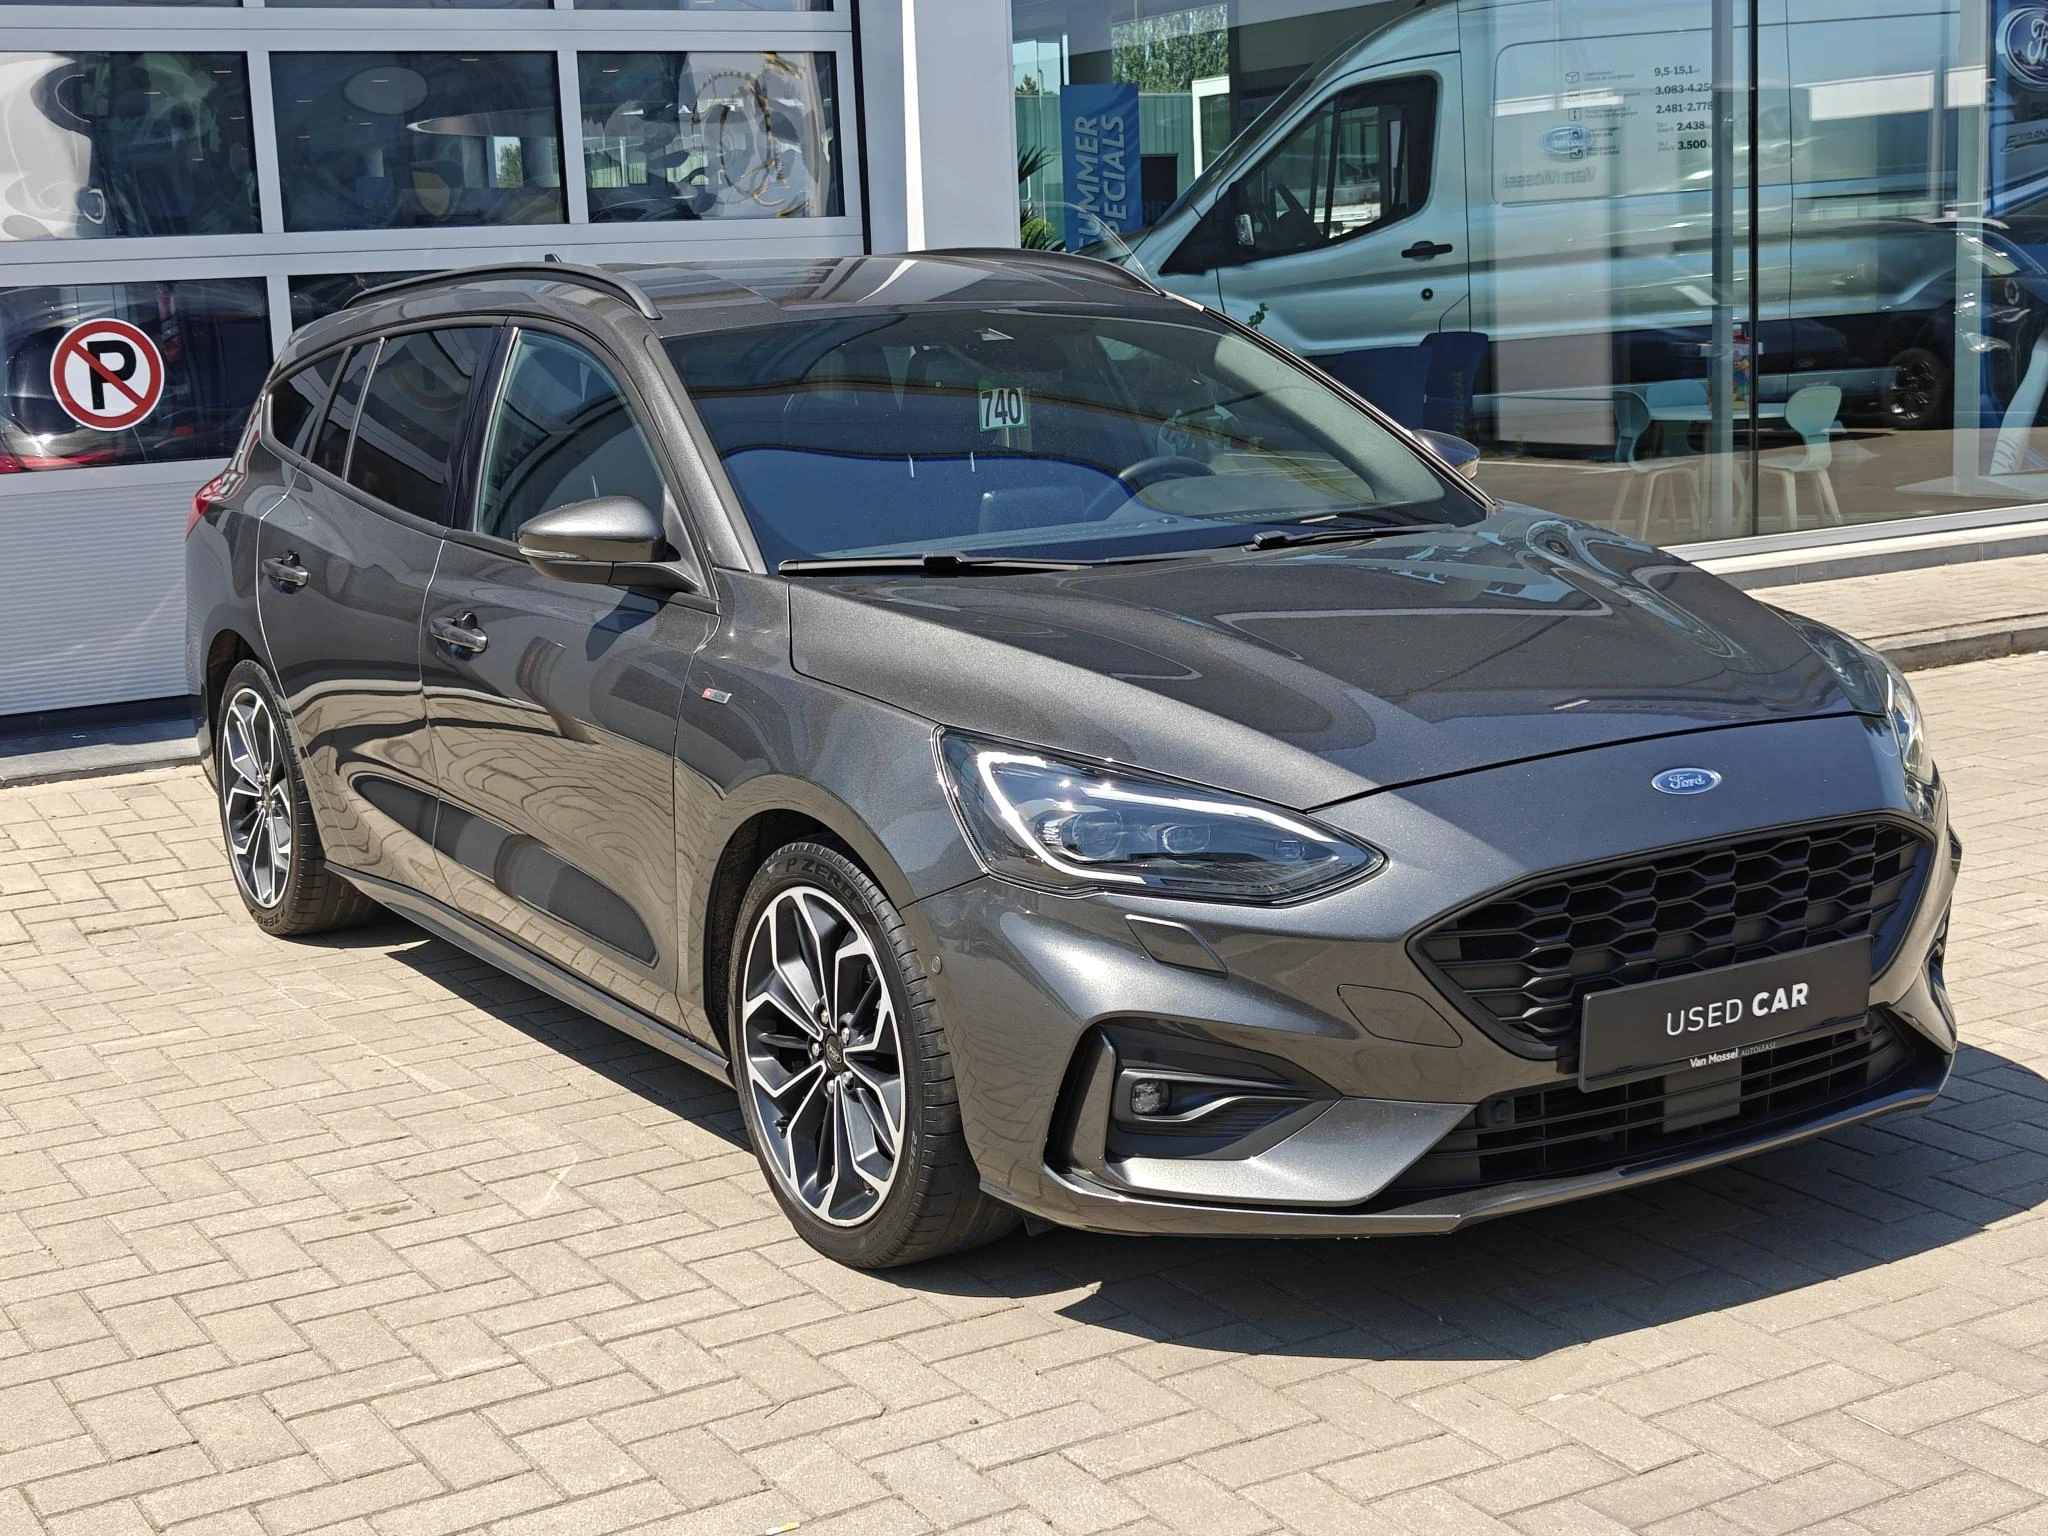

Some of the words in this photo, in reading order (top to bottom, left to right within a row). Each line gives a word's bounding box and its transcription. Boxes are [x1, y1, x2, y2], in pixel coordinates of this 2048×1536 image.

[1677, 121, 1705, 132] 2.438
[1677, 139, 1707, 151] 3.500
[87, 339, 137, 410] P
[981, 388, 1022, 428] 740
[1668, 773, 1706, 790] Ford
[1665, 998, 1744, 1036] USED
[1750, 982, 1810, 1018] CAR
[1689, 1057, 1707, 1069] Van
[1708, 1047, 1739, 1065] Mossel
[1740, 1041, 1777, 1057] AUTOLEASE
